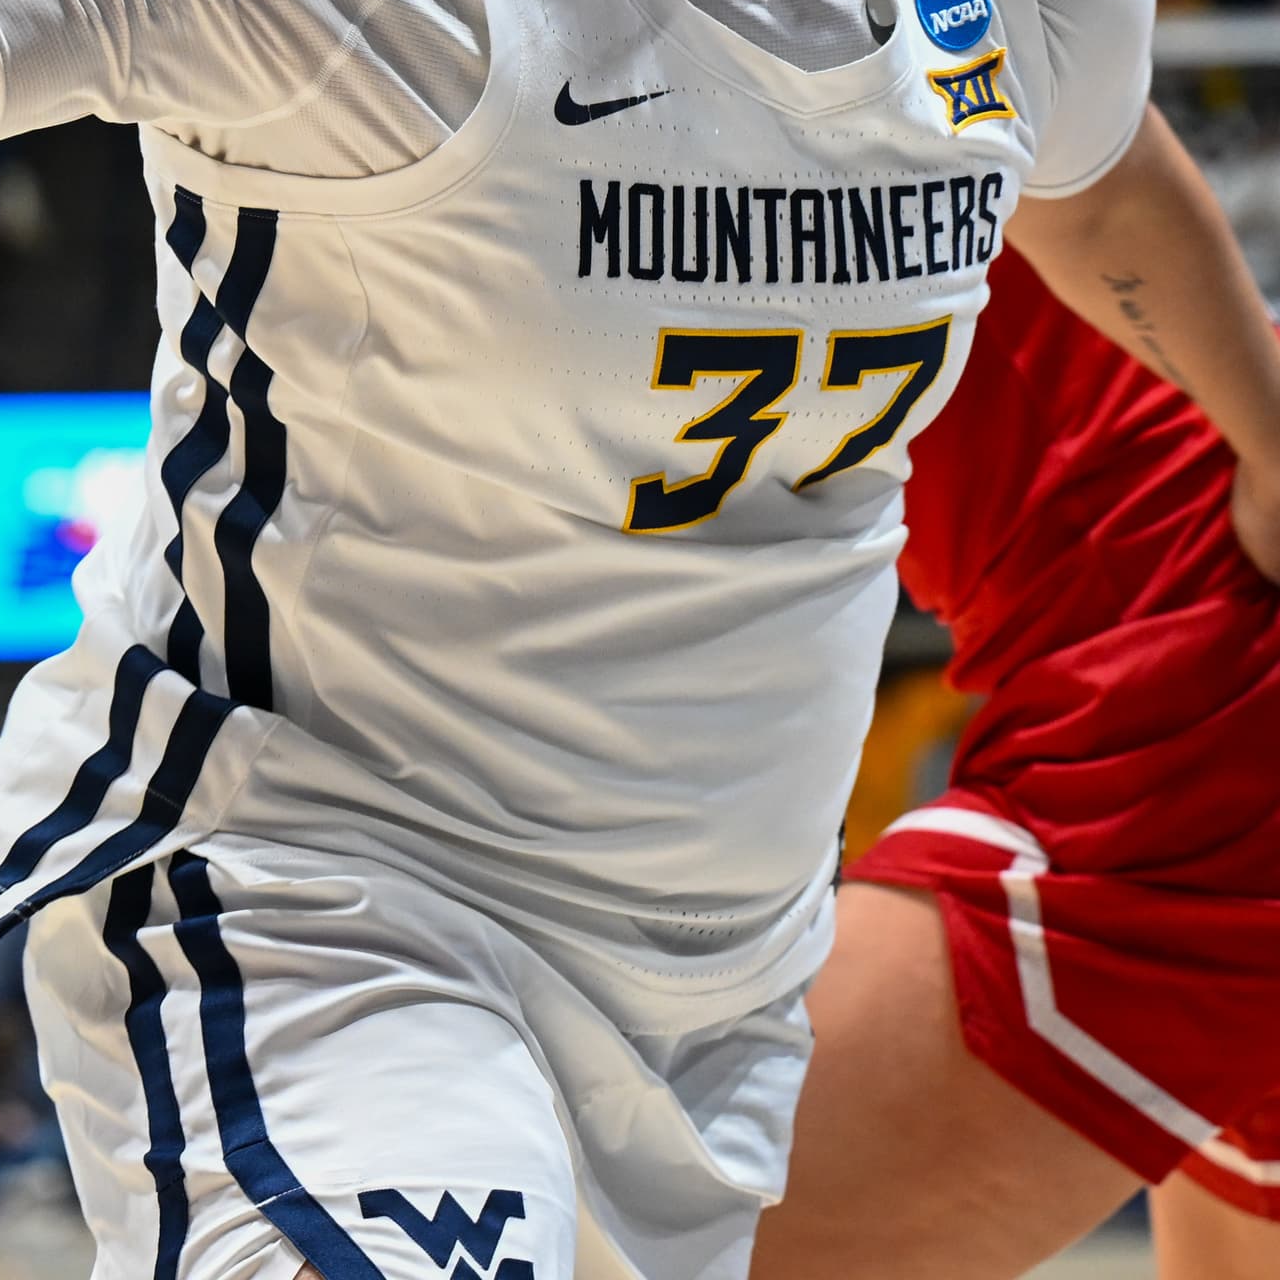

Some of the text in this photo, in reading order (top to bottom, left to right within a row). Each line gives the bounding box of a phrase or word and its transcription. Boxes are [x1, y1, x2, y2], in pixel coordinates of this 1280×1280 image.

[933, 57, 1009, 125] XII
[577, 171, 1005, 284] MOUNTAINEERS
[621, 312, 954, 535] 37
